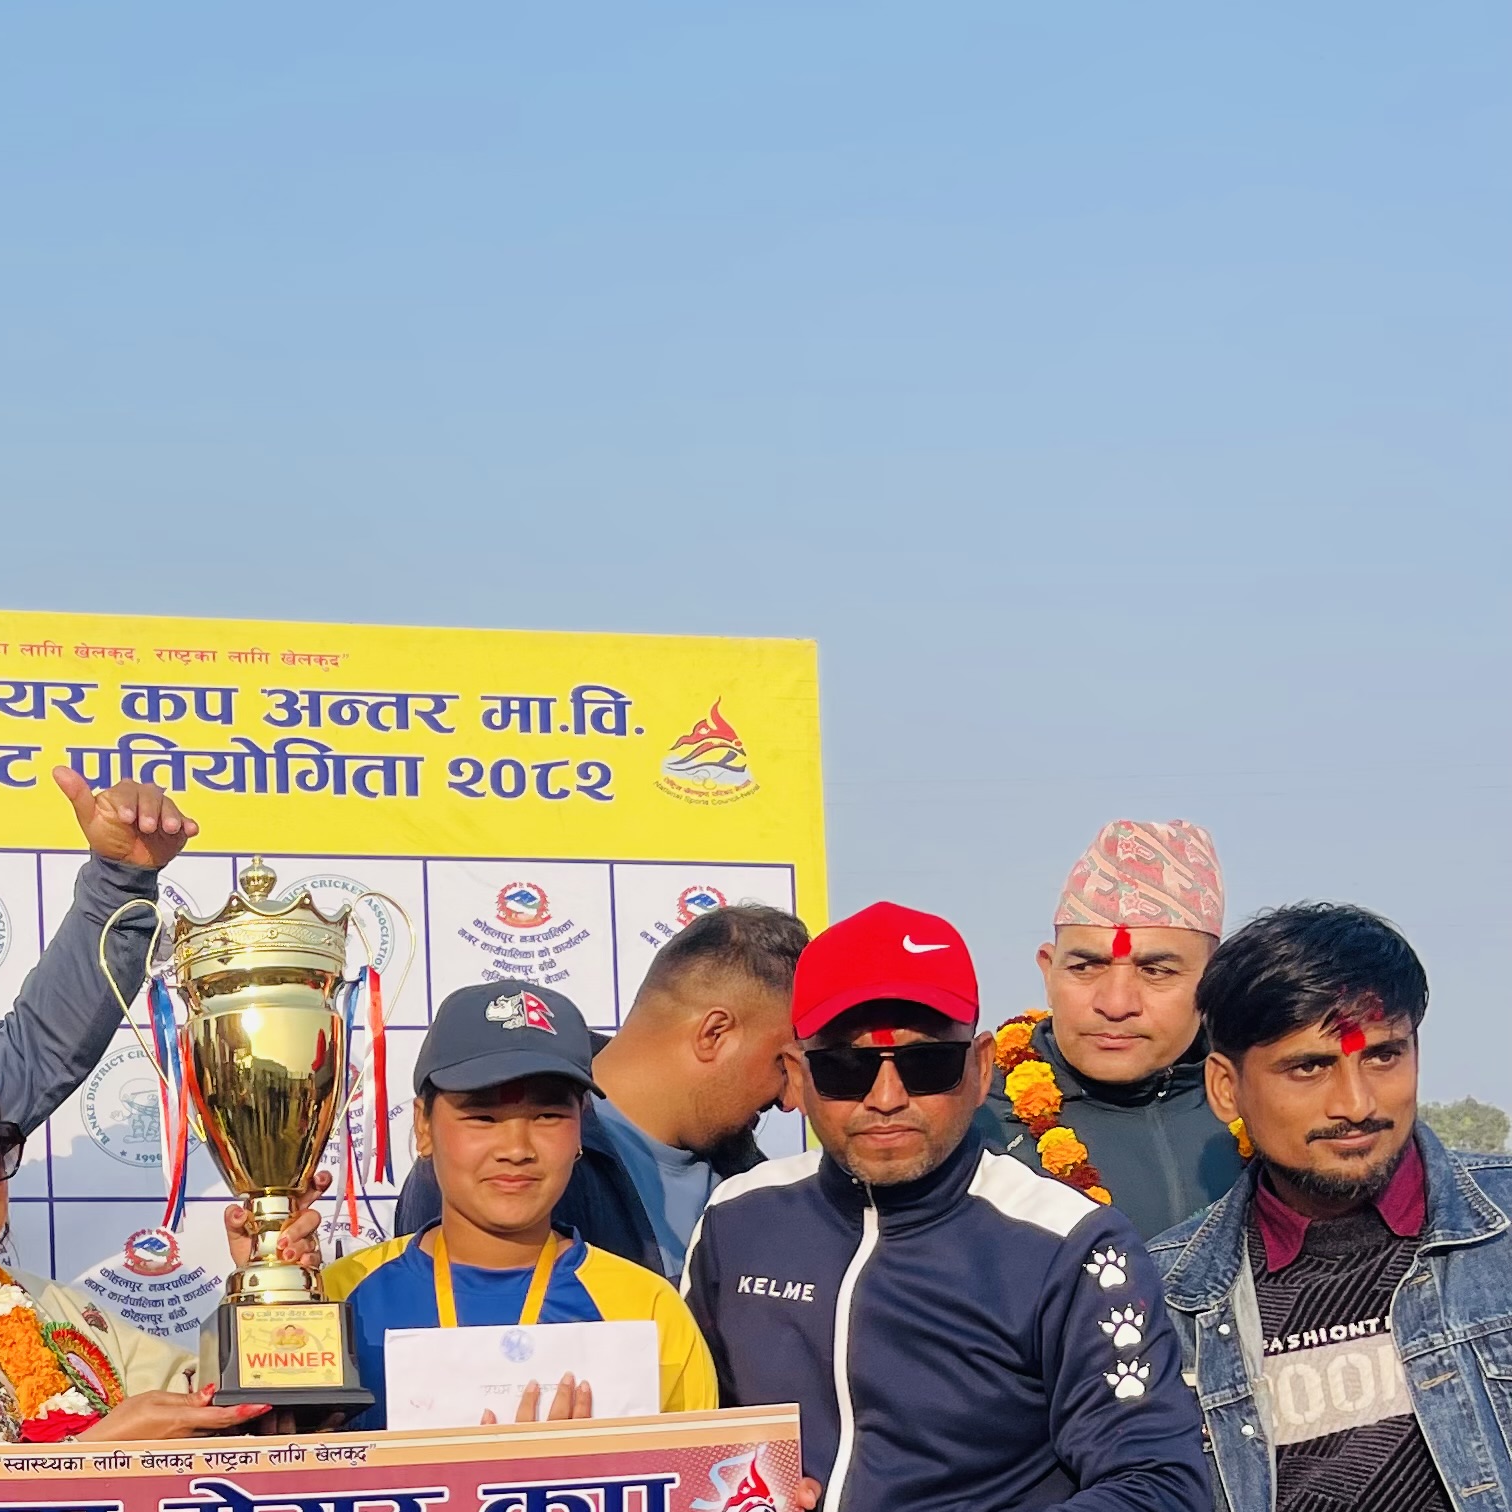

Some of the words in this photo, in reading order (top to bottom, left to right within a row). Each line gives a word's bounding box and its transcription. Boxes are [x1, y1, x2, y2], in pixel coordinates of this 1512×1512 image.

[19, 640, 64, 658] लागि
[228, 647, 271, 665] लागि
[121, 681, 239, 725] कप
[260, 684, 460, 735] अन्तर
[480, 684, 645, 738] मा.वि.
[65, 733, 425, 799] प्रतियोगिता
[446, 756, 617, 802] २०८२
[737, 1275, 816, 1302] KELME
[246, 1351, 337, 1369] WINNER
[93, 1450, 131, 1471] लागि
[140, 1451, 194, 1475] खेलकुद
[202, 1450, 261, 1472] राष्ट्रका
[267, 1443, 307, 1466] लागि
